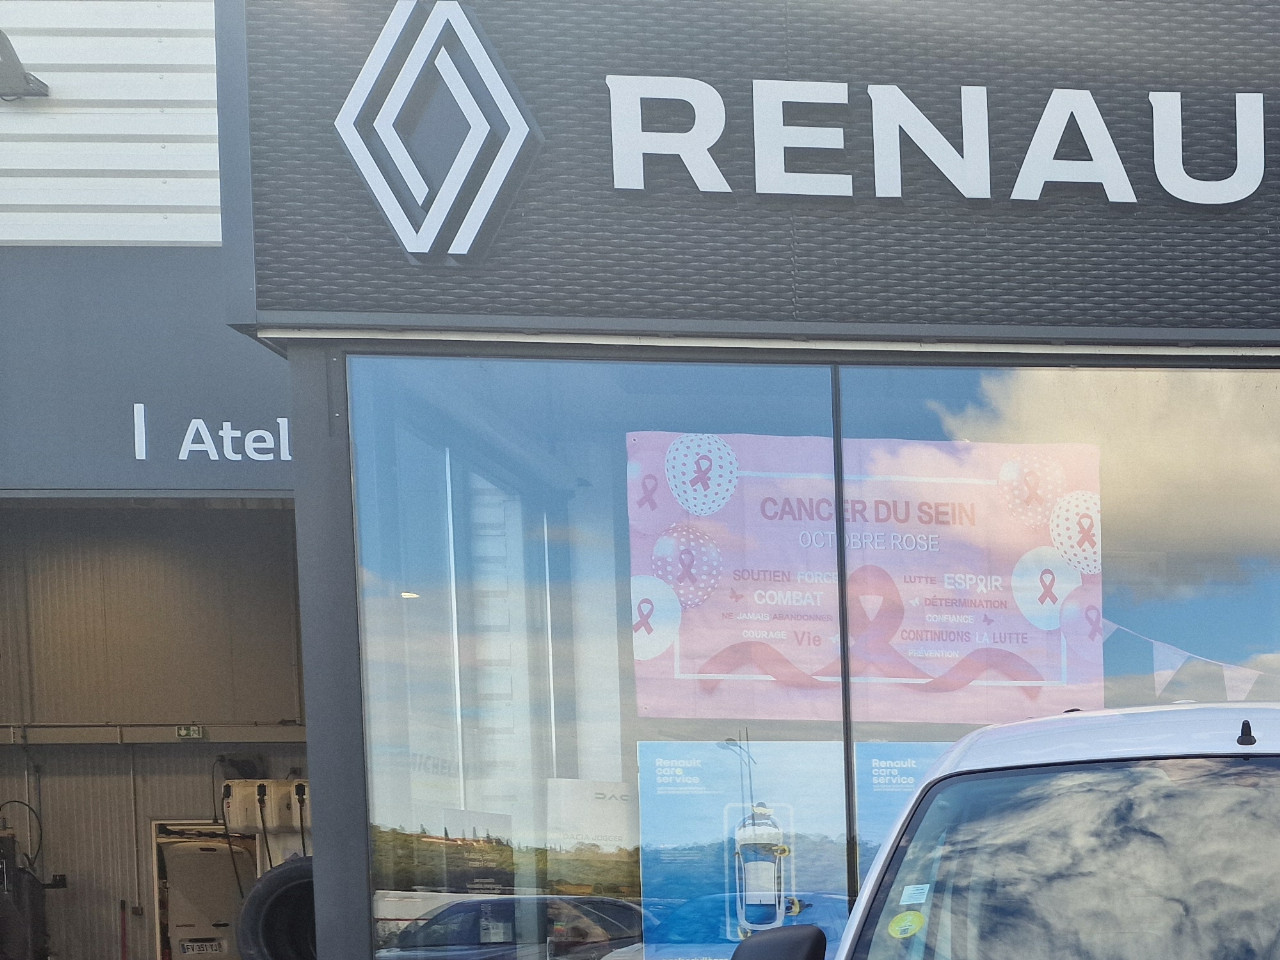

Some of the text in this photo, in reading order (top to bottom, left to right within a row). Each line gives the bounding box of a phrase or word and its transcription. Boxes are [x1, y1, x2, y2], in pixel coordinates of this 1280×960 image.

[874, 500, 910, 524] DU
[917, 501, 976, 526] SEIN
[891, 533, 940, 551] ROSE
[733, 569, 791, 583] SOUTIEN
[903, 575, 937, 585] LUTTE
[754, 590, 824, 606] COMBAT
[924, 596, 1008, 609] DÉTERMINATION
[926, 614, 975, 623] CONFIANCE
[742, 630, 822, 647] COURAGE Vie
[901, 629, 1028, 644] CONTINUONS LA LUTTE
[656, 758, 702, 767] Renault
[872, 758, 917, 768] Renault
[656, 768, 684, 776] care
[872, 768, 898, 776] care
[656, 775, 700, 784] service
[872, 775, 915, 784] service
